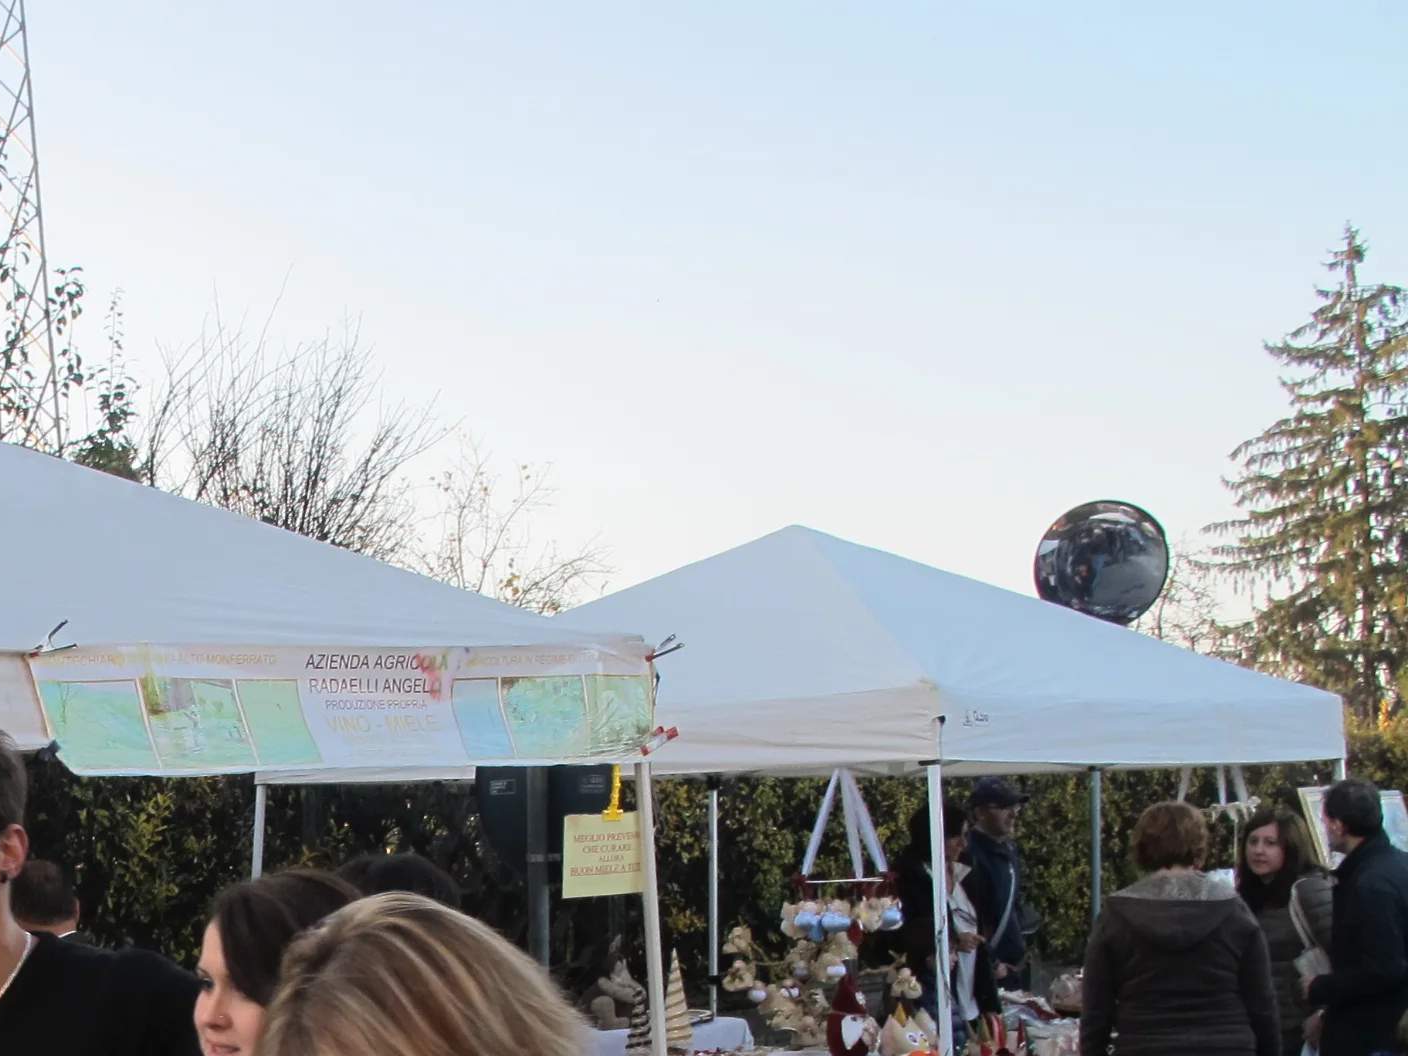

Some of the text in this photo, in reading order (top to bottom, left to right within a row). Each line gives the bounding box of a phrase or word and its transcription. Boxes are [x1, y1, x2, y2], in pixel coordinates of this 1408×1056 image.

[178, 653, 204, 665] ALTO
[206, 653, 277, 666] MONFERRATO
[305, 653, 449, 671] AZIENDA AGRICOLA
[308, 678, 442, 694] RADAELLI ANGELO
[324, 699, 428, 710] PRODUZIONE PROPRIA
[324, 715, 371, 733] VINO
[384, 714, 442, 732] MIELE
[573, 833, 605, 843] MEGLIO
[582, 843, 632, 854] CHE CURARE
[599, 854, 624, 862] ALLORA
[571, 866, 593, 876] BUON
[595, 864, 619, 874] MIELE
